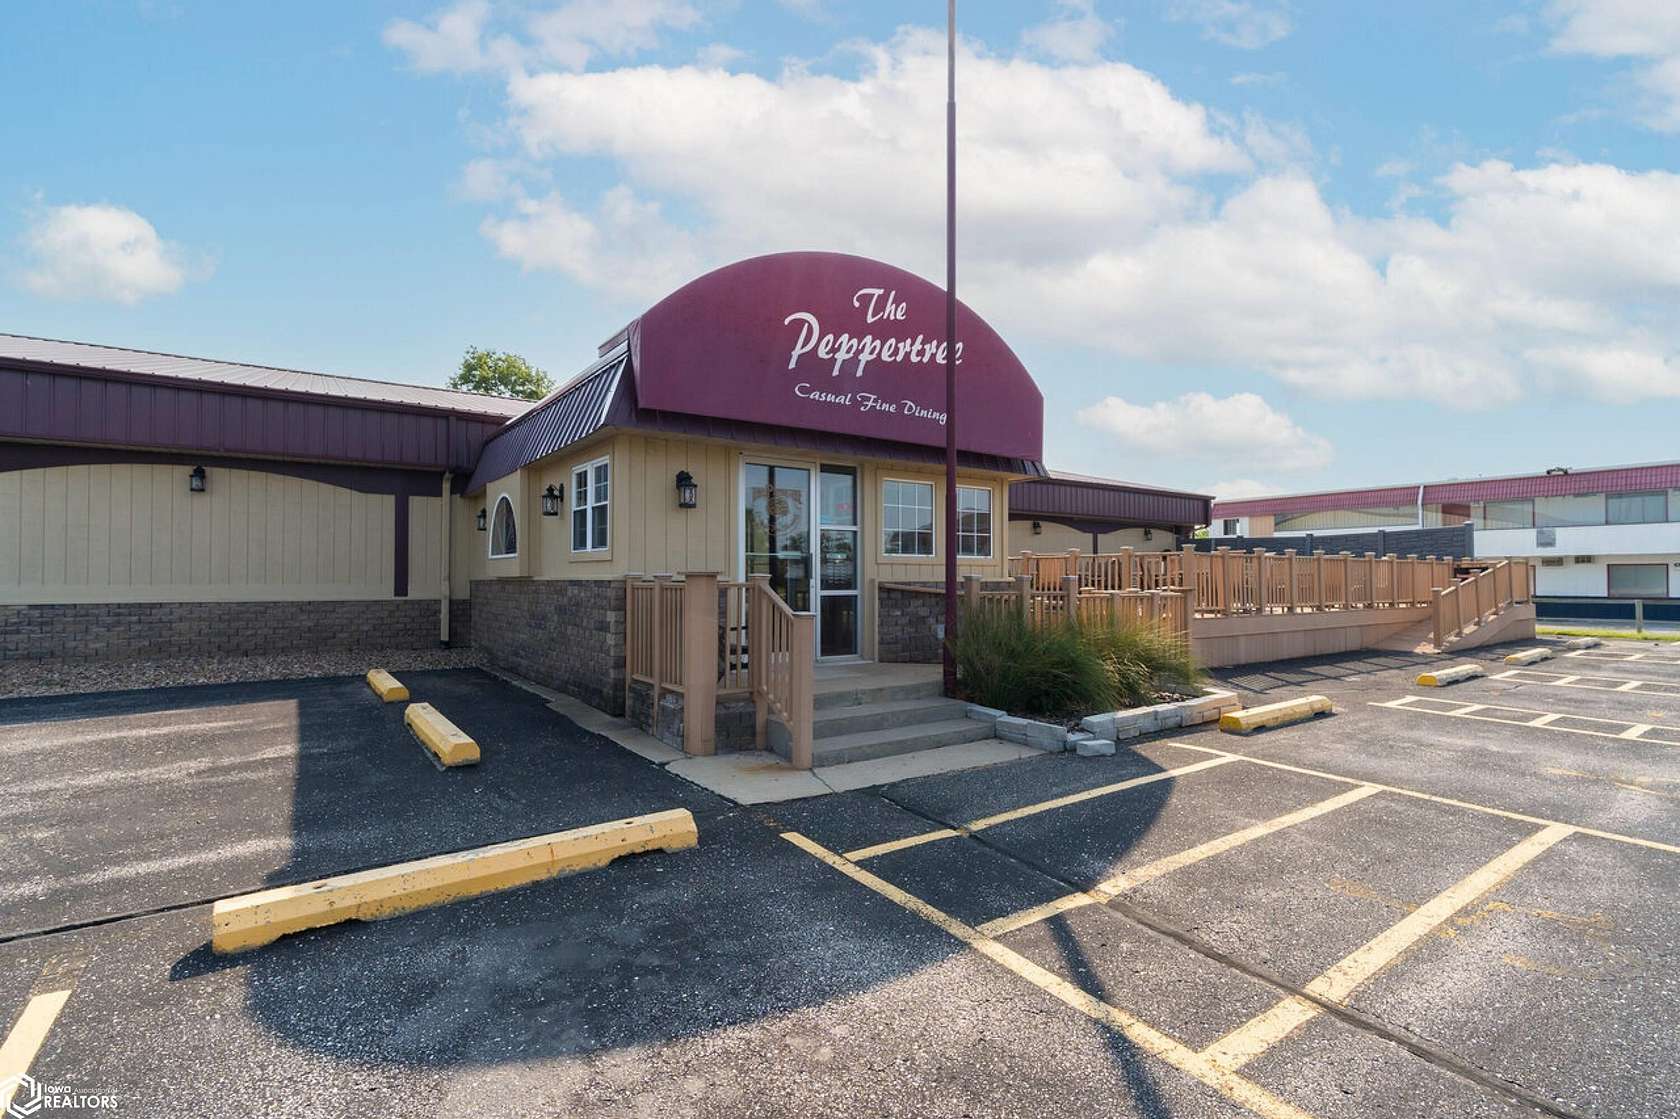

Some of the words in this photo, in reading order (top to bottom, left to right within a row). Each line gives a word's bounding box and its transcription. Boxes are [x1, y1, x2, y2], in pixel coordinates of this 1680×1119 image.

[853, 288, 907, 323] The
[795, 383, 852, 405] Casual
[856, 393, 897, 412] Fine
[901, 400, 948, 425] Dining
